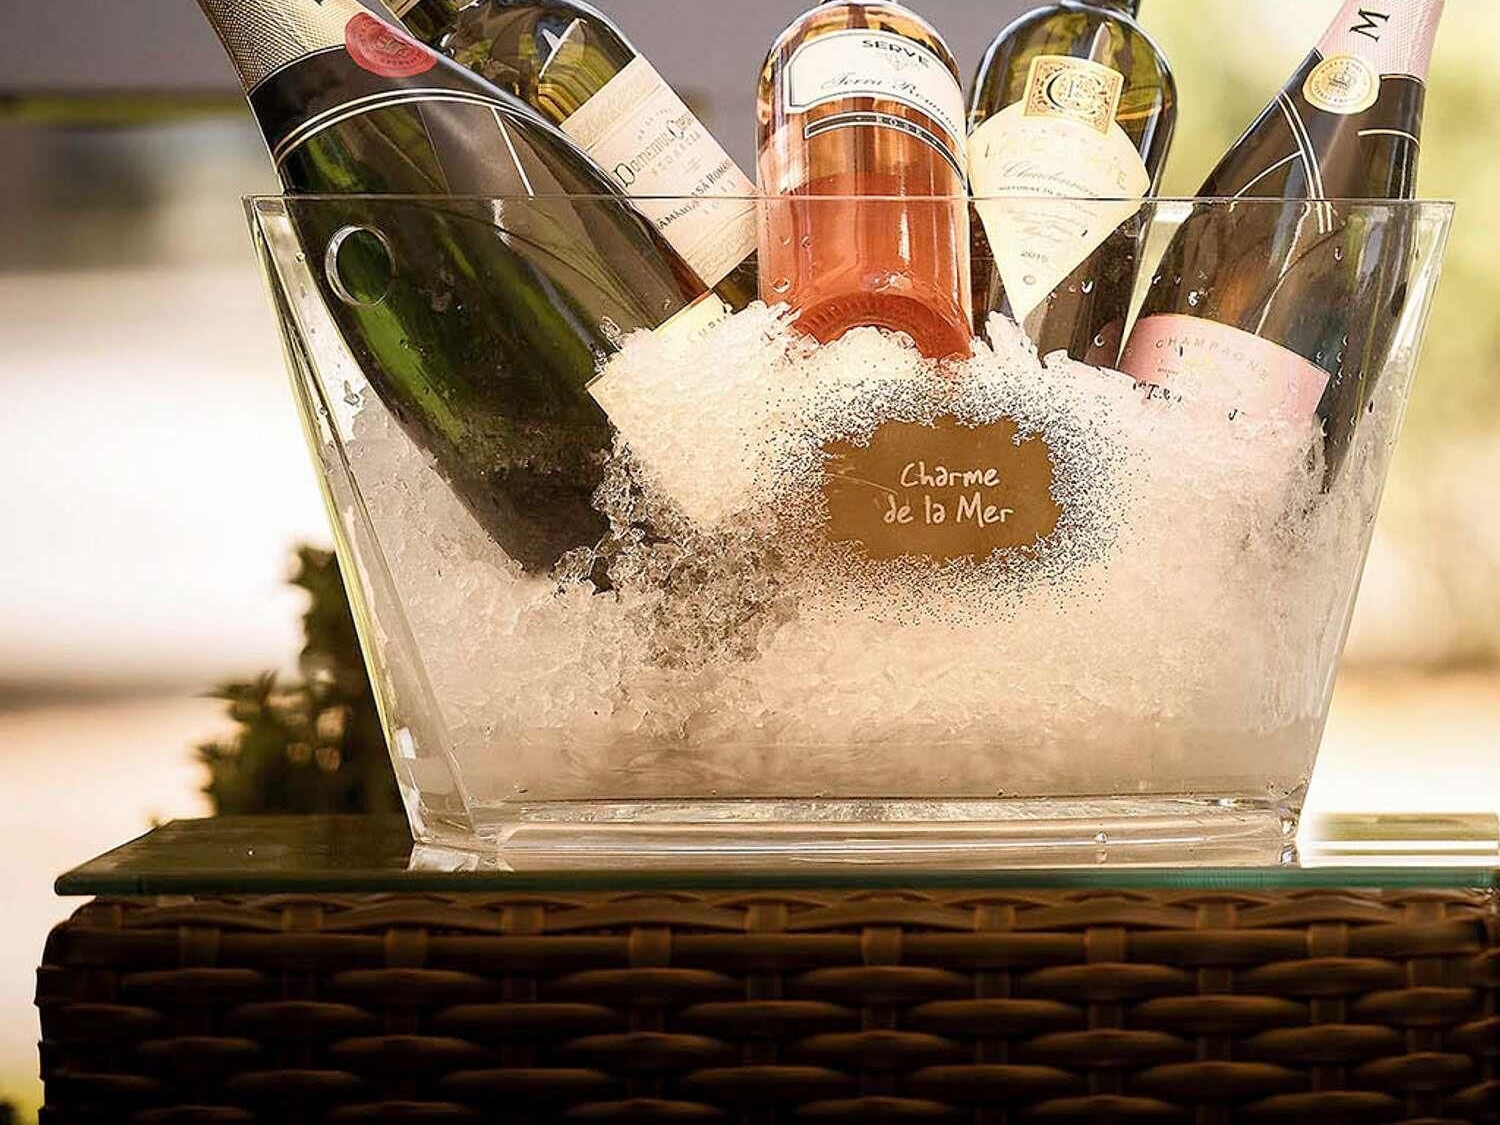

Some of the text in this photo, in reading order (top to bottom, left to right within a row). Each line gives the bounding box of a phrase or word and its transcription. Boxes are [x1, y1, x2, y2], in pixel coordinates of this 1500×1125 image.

[862, 39, 930, 69] SERVE
[900, 461, 1000, 488] Charme
[883, 491, 1014, 528] de la Mer
